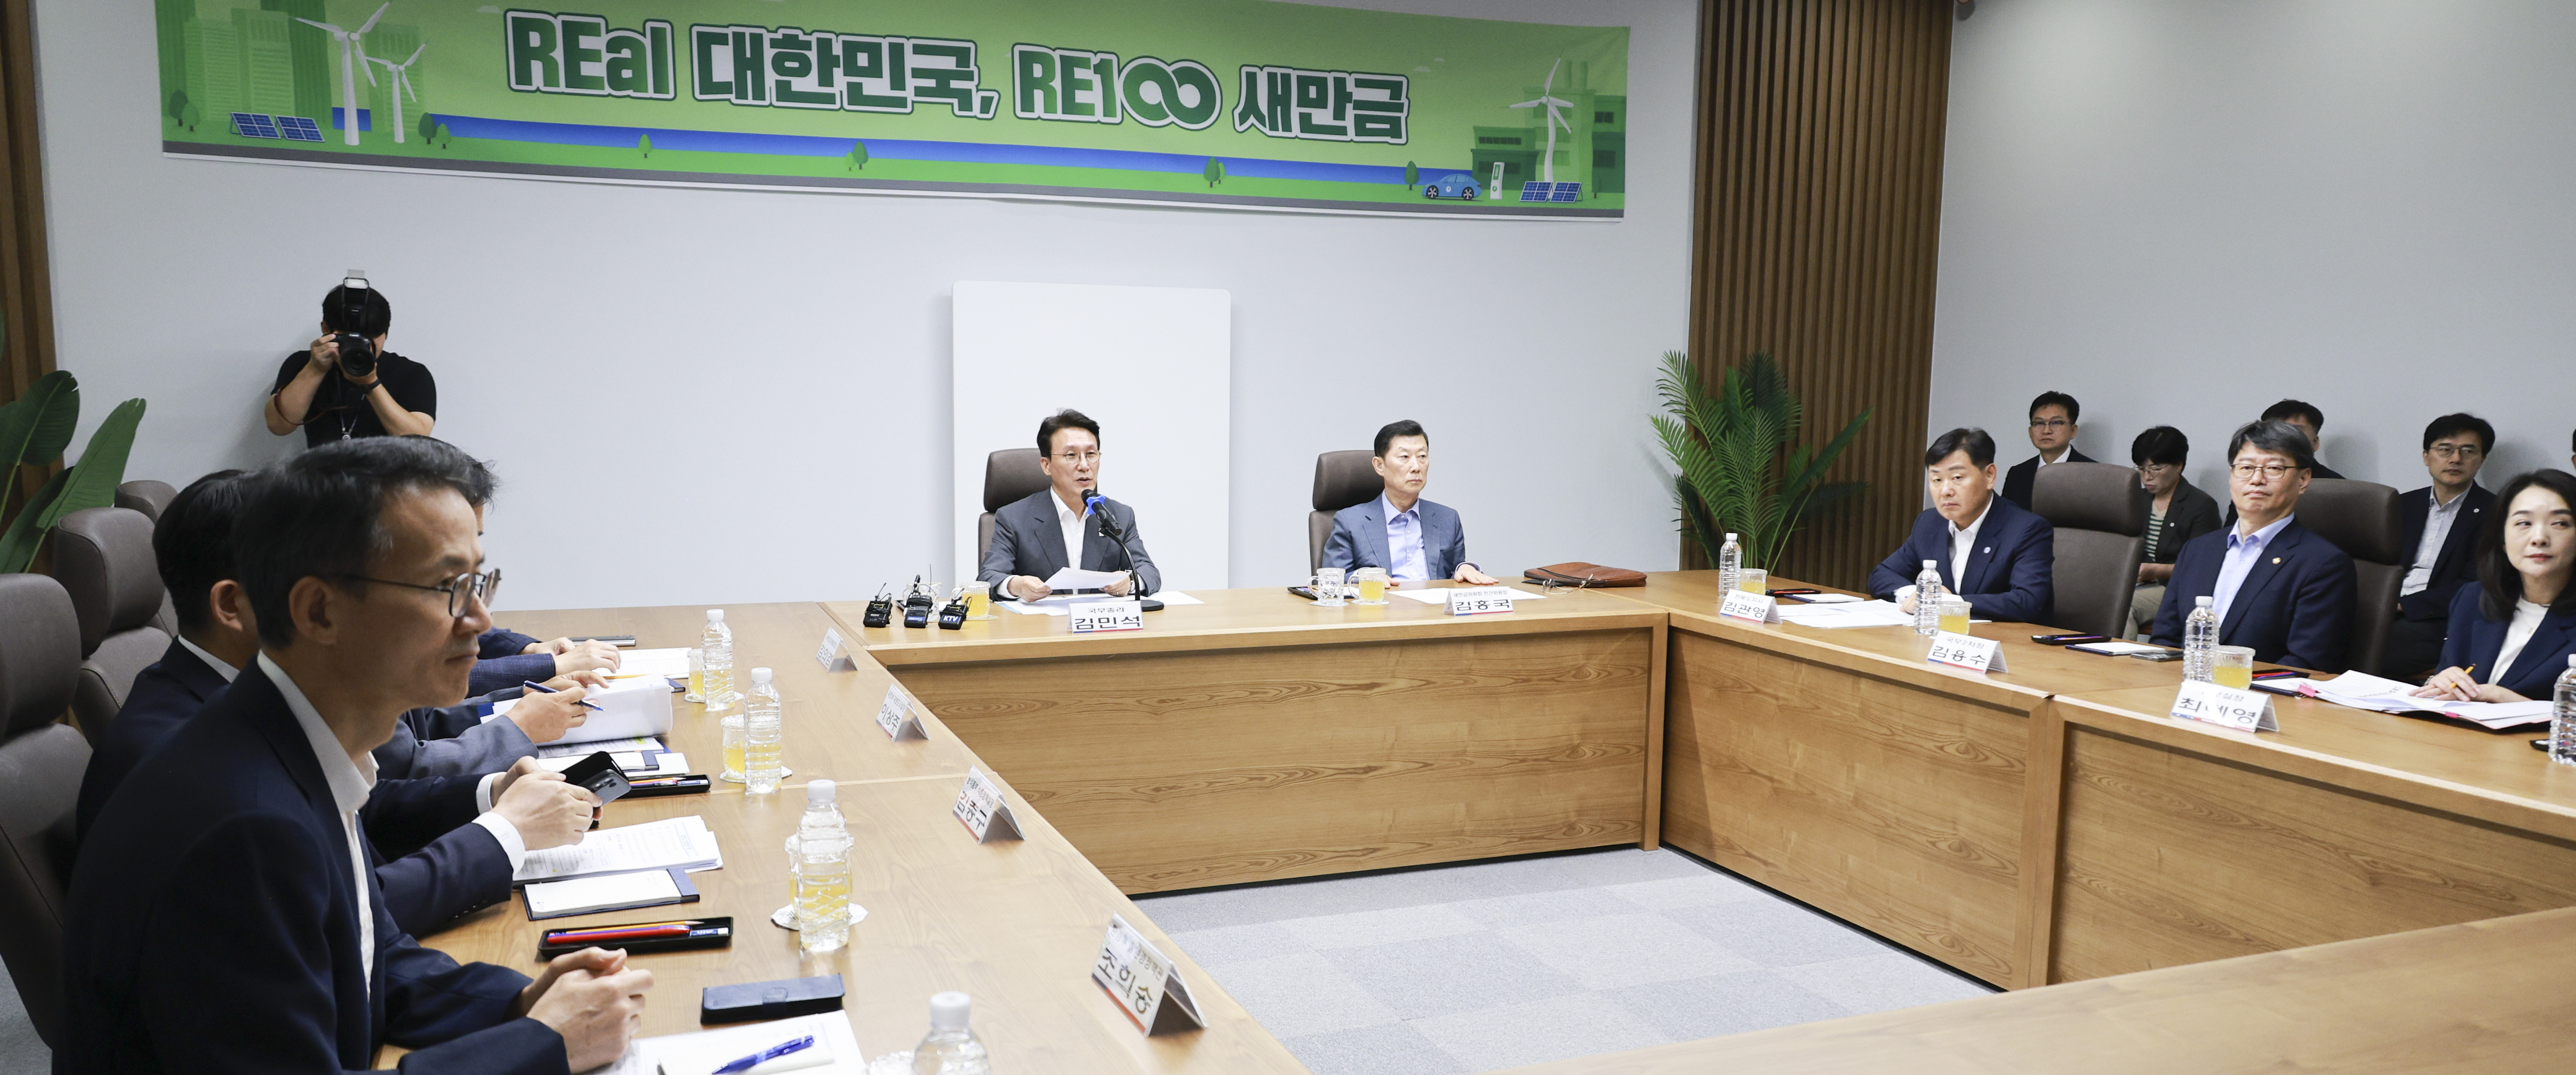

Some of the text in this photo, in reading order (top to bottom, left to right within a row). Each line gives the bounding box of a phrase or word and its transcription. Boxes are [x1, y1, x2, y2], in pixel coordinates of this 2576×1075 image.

[506, 10, 674, 100] REal
[691, 24, 1000, 119] 대한민국,
[1234, 65, 1409, 144] 새만금
[1455, 599, 1509, 611] 김홍국
[1724, 602, 1765, 618] 김관영
[1075, 616, 1140, 629] 김민석
[1947, 637, 1984, 649] 국무2차장
[817, 644, 833, 667] 김의겸
[1933, 646, 1986, 665] 김용수
[881, 704, 900, 731] 이상주
[957, 791, 987, 831] 김종구
[1098, 947, 1153, 1014] 조희송
